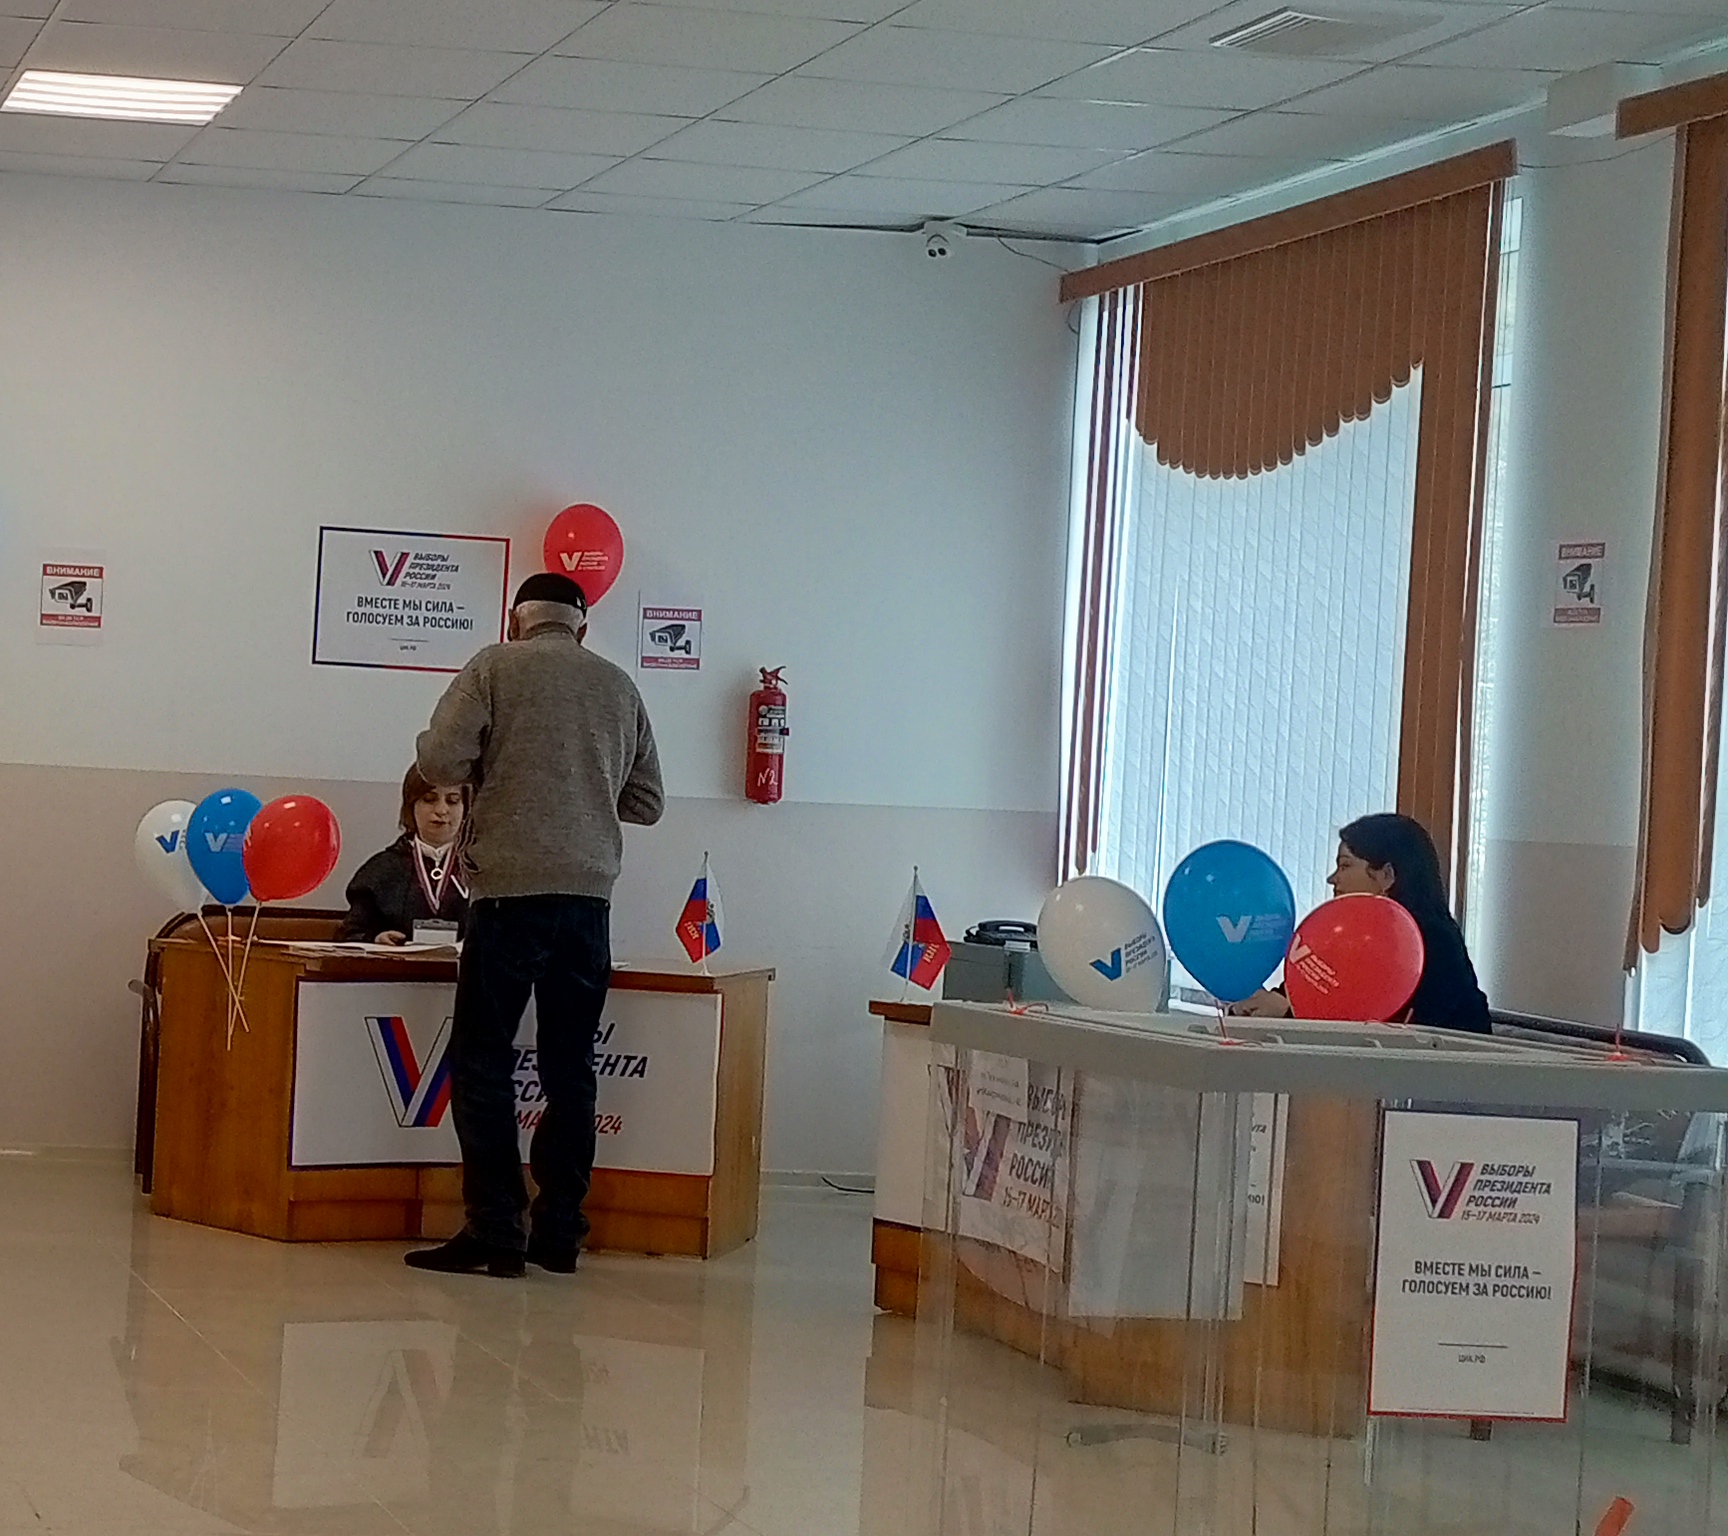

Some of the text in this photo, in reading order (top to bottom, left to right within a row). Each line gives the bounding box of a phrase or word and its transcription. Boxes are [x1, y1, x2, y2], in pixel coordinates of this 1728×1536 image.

[413, 552, 450, 562] ВЫБОРЫ
[46, 566, 100, 577] ВНИМАНИЕ
[408, 562, 459, 572] ПРЕЗИДЕНТА
[404, 571, 437, 580] РОССИИ
[357, 596, 400, 610] ВМЕСТЕ
[402, 598, 422, 612] МЫ
[425, 600, 454, 614] СИЛА
[346, 611, 474, 631] ГОЛОСУЕМ ЗА РОССИЮ!
[646, 610, 699, 620] ВНИМАНИЕ
[1480, 1162, 1536, 1177] ВЫБОРЫ
[1472, 1179, 1552, 1195] ПРЕЗИДЕНТА
[1465, 1195, 1518, 1208] РОССИИ
[1486, 1212, 1518, 1223] МАРТА
[1518, 1213, 1540, 1224] 2024
[1414, 1260, 1465, 1277] ВМЕСТЕ
[1468, 1263, 1492, 1278] МЫ
[1494, 1265, 1529, 1280] СИЛА
[1402, 1279, 1552, 1300] ГОЛОСУЕМ ЗА РОССИЮ!
